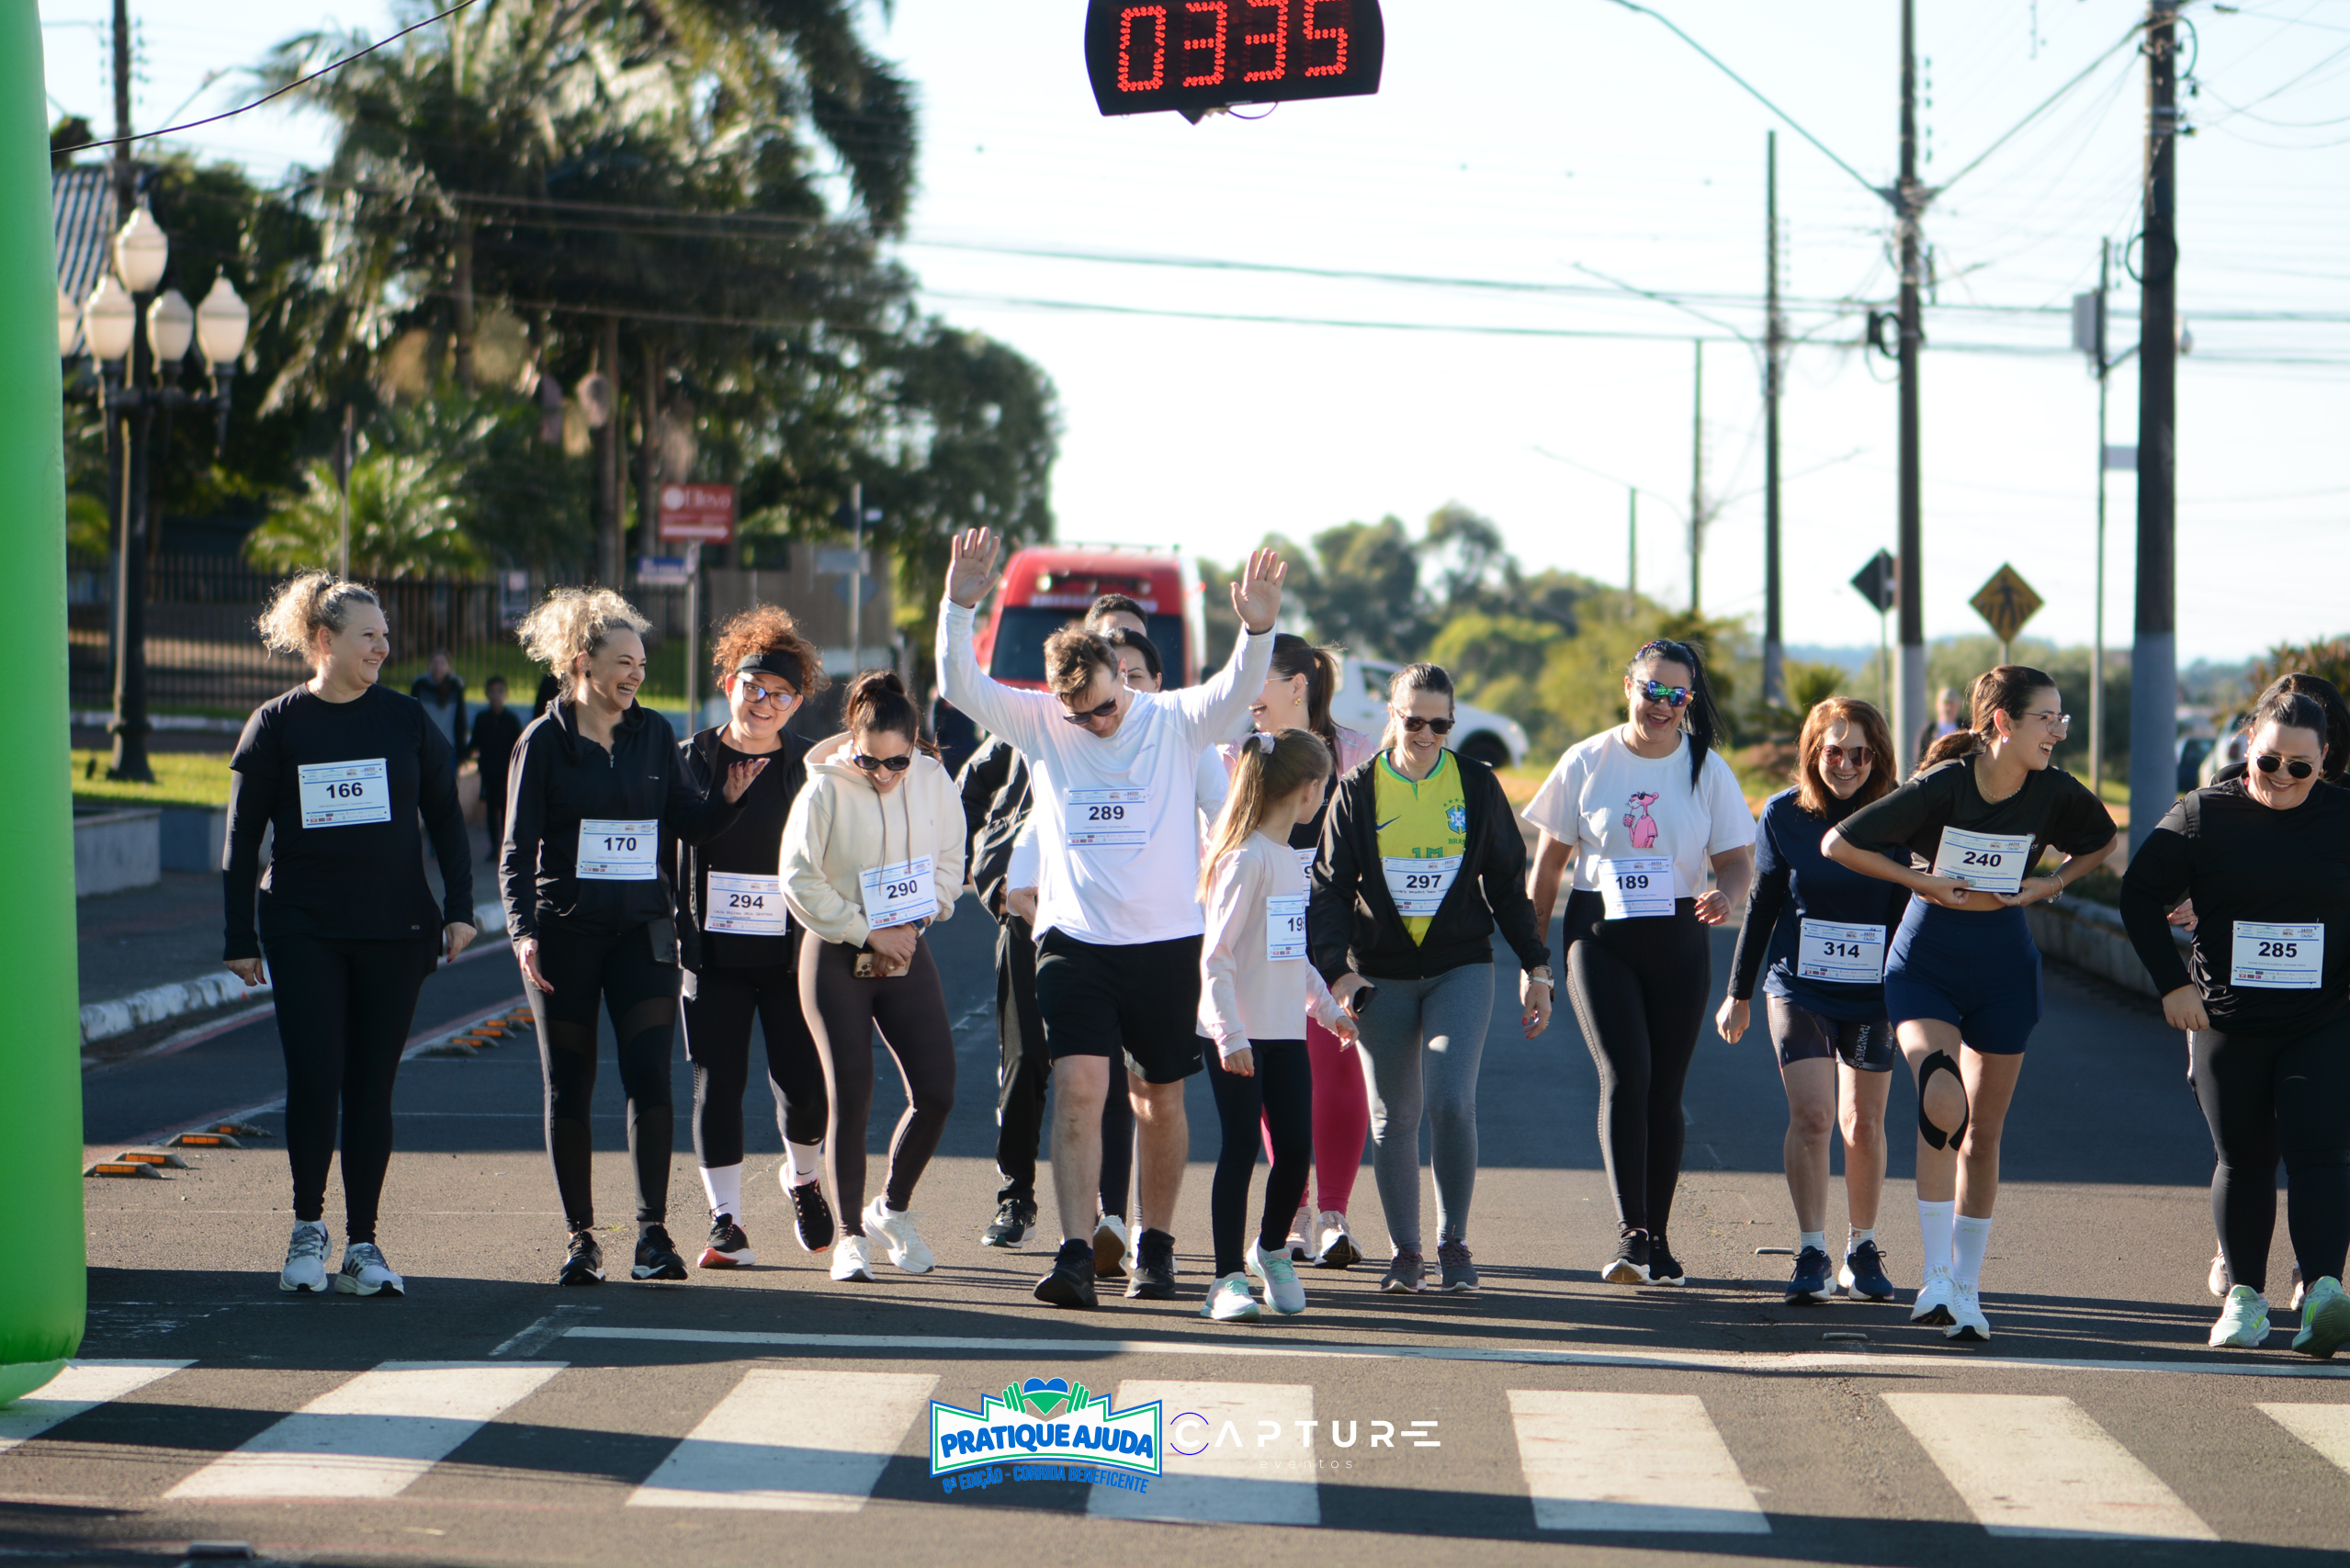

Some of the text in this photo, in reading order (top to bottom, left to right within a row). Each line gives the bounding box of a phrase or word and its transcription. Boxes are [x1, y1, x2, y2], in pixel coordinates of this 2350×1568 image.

[326, 782, 364, 799] 166
[1089, 806, 1124, 821] 289
[604, 837, 638, 852] 170
[1962, 851, 2002, 867] 240
[887, 879, 918, 899] 290
[1406, 874, 1442, 889] 297
[1616, 874, 1649, 890] 189
[729, 894, 764, 909] 294
[1287, 917, 1305, 931] 19
[1824, 942, 1860, 959] 314
[2258, 942, 2298, 958] 285
